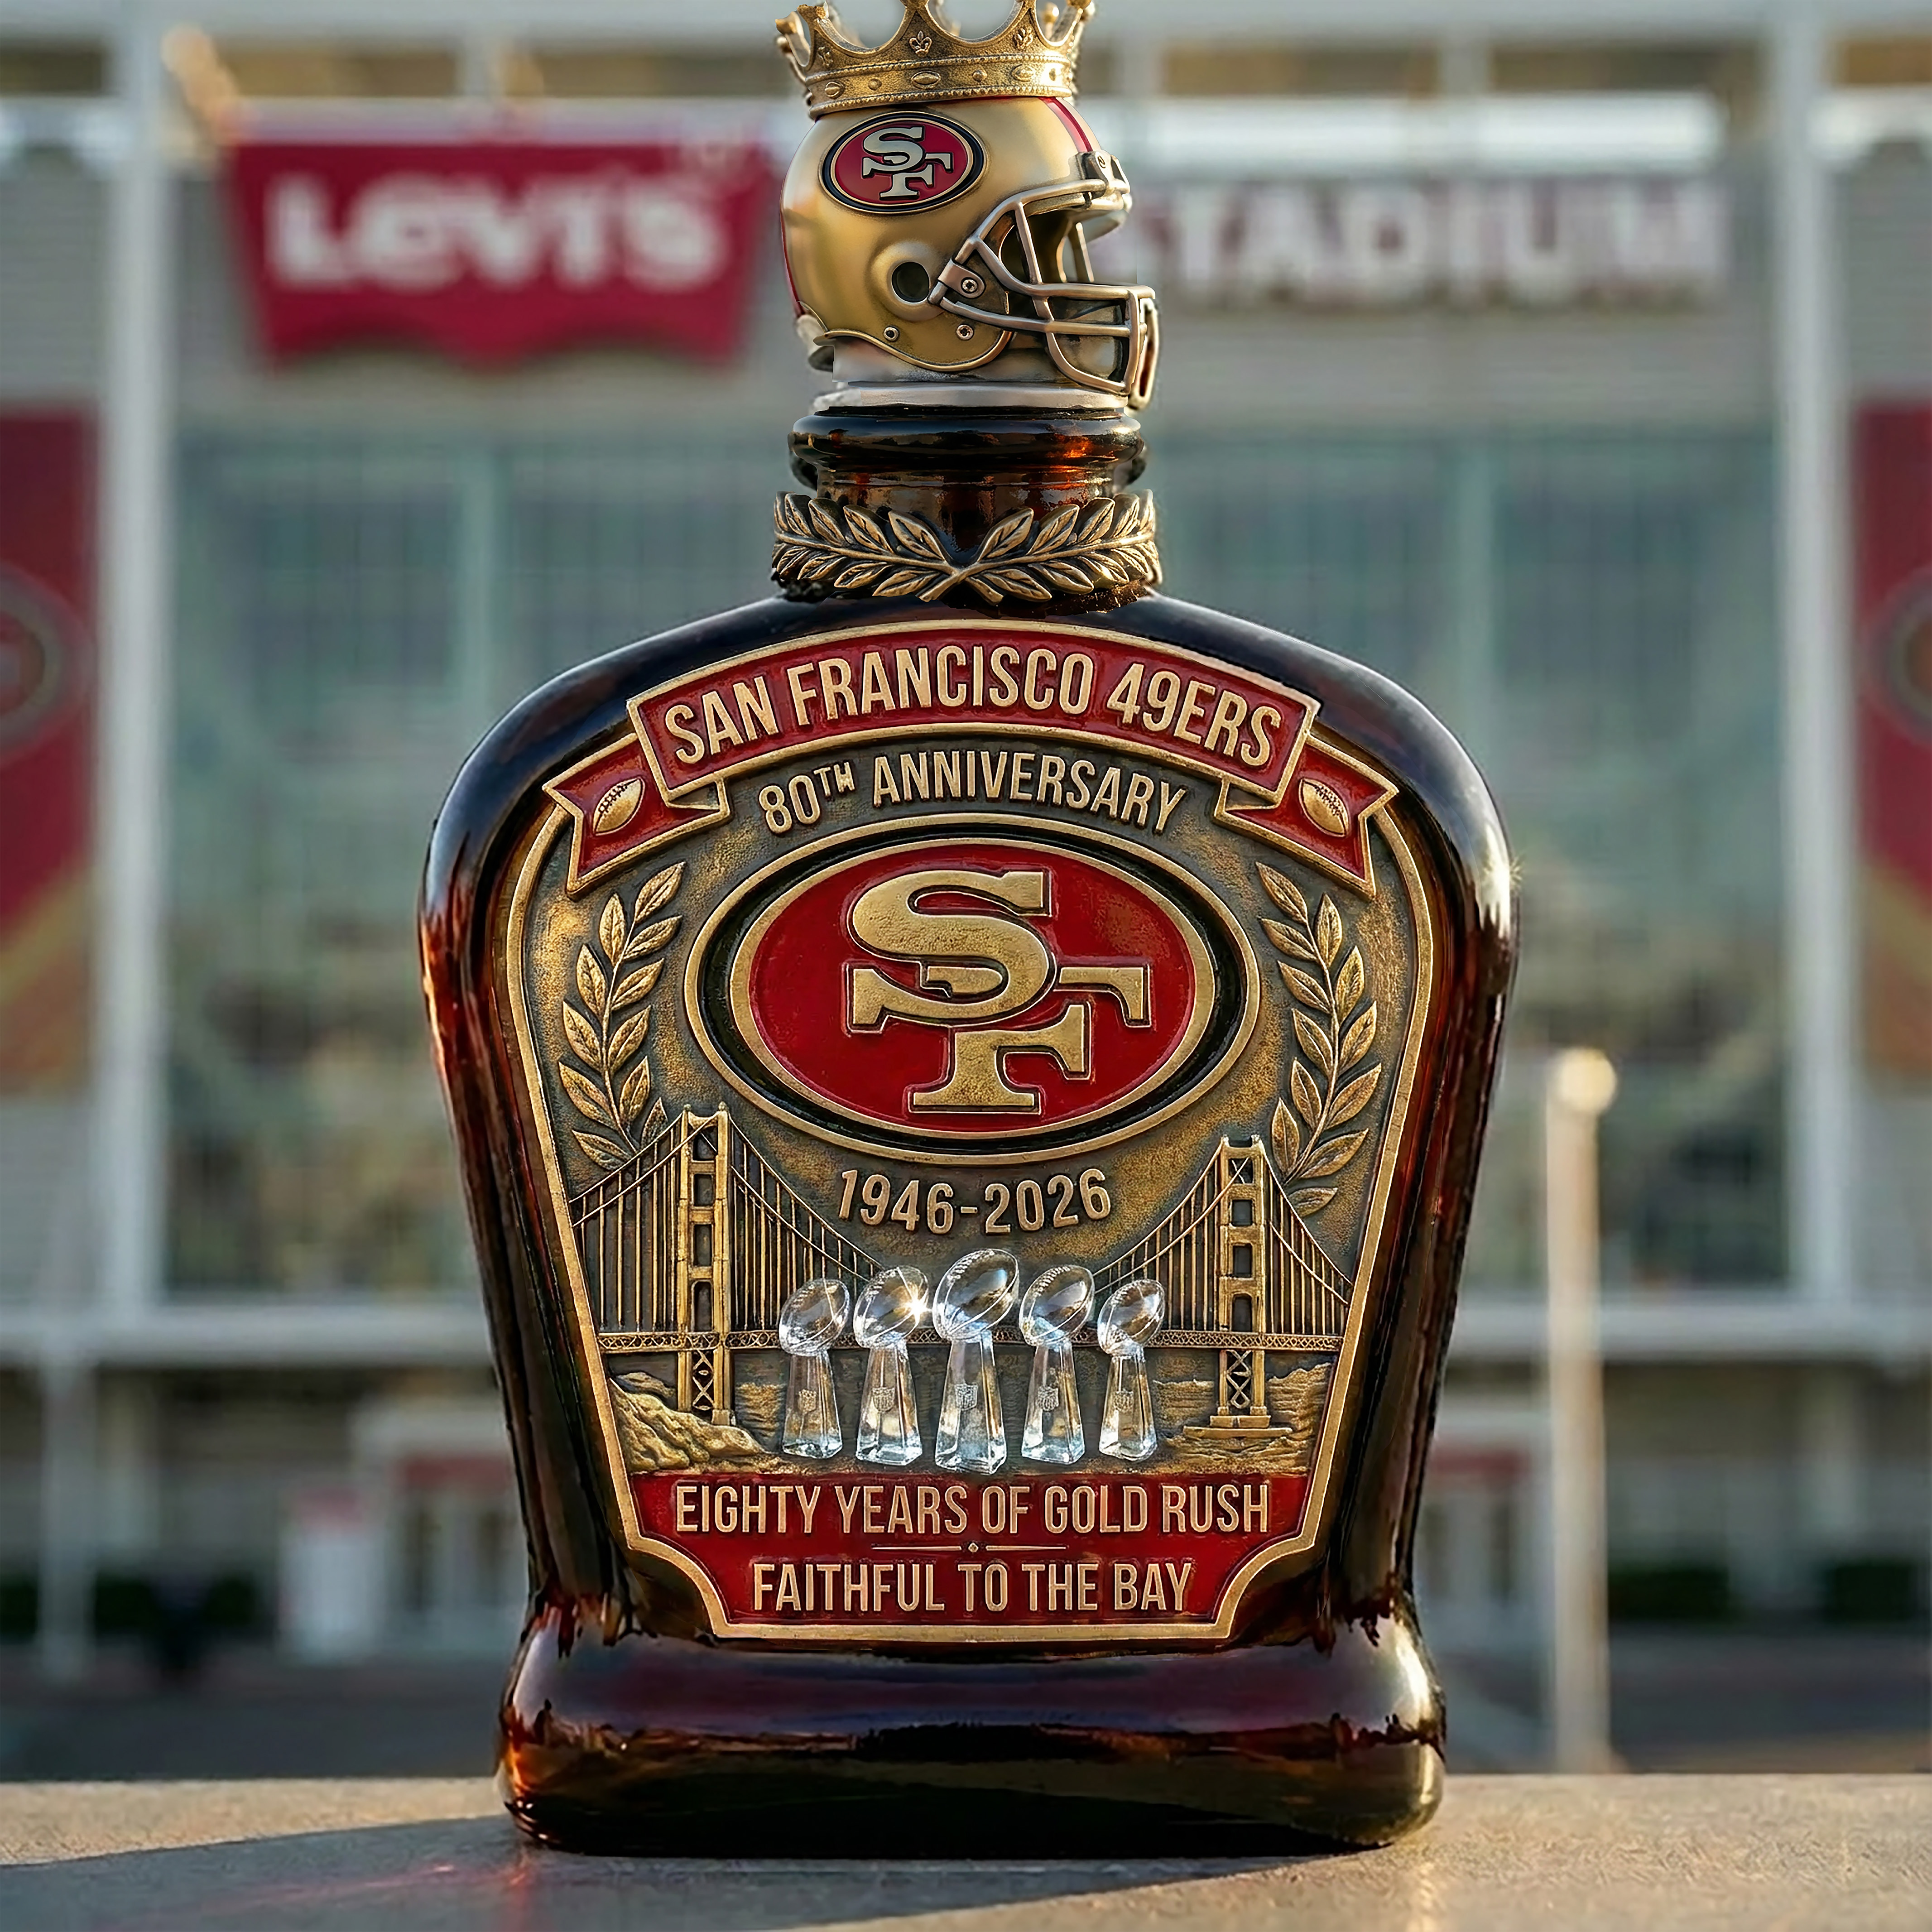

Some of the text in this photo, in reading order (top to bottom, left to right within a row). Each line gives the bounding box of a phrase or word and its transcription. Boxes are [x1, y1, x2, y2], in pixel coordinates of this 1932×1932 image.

[665, 644, 1282, 767] SAN FRANCISCO 49ERS
[872, 750, 1187, 834] ANNIVERSARY
[847, 869, 1153, 1115] SF
[839, 1168, 1112, 1235] 1946-2026
[674, 1484, 1269, 1534] EIGHTY YEARS OF GOLD RUSH
[753, 1562, 1193, 1612] FAITHFUL TO THE BAY
